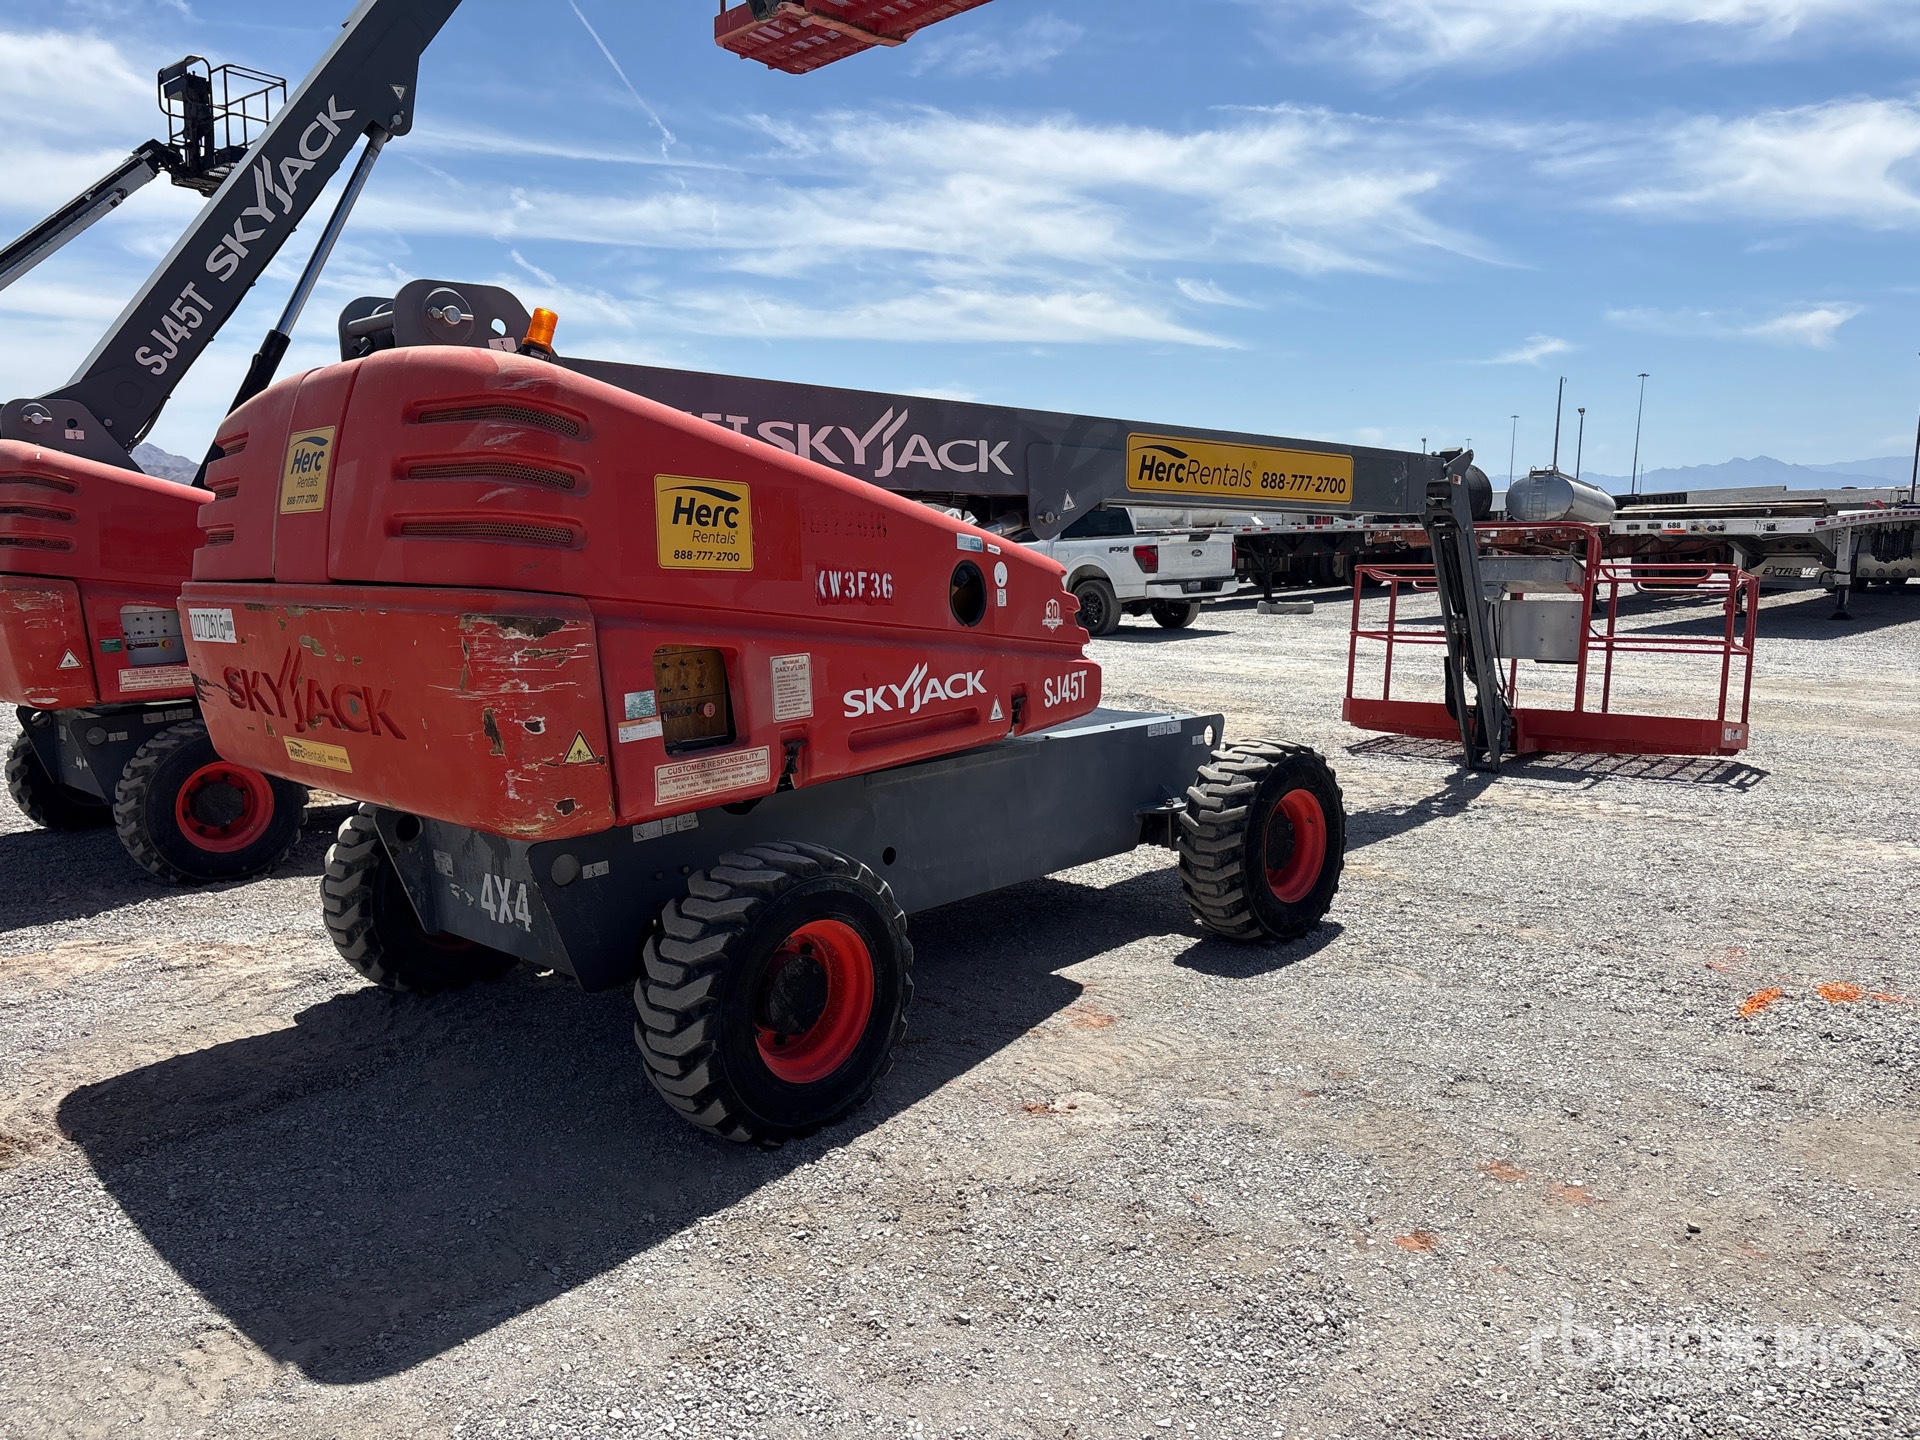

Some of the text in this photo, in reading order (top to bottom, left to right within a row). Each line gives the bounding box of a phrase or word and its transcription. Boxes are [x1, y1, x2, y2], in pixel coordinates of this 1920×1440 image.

[134, 94, 357, 376] SJ45T SKYJACK
[756, 405, 1015, 478] SKYJACK
[290, 448, 325, 475] Herc
[1260, 471, 1346, 494] 888-777-2700
[286, 493, 318, 506] 888-777-2700
[672, 496, 739, 529] Herc
[1667, 521, 1682, 529] 688
[673, 549, 740, 562] 888-777-2700
[1108, 545, 1130, 554] FX4
[1761, 565, 1819, 577] EXTREME
[1047, 602, 1058, 619] 30
[189, 614, 226, 641] 10172616
[223, 645, 407, 741] SKYJACK
[842, 661, 988, 718] SKYJACK
[1043, 669, 1088, 709] SJ45T
[667, 752, 759, 776] CUSTOMER RESPONSIBILITY
[480, 872, 532, 933] 4X4
